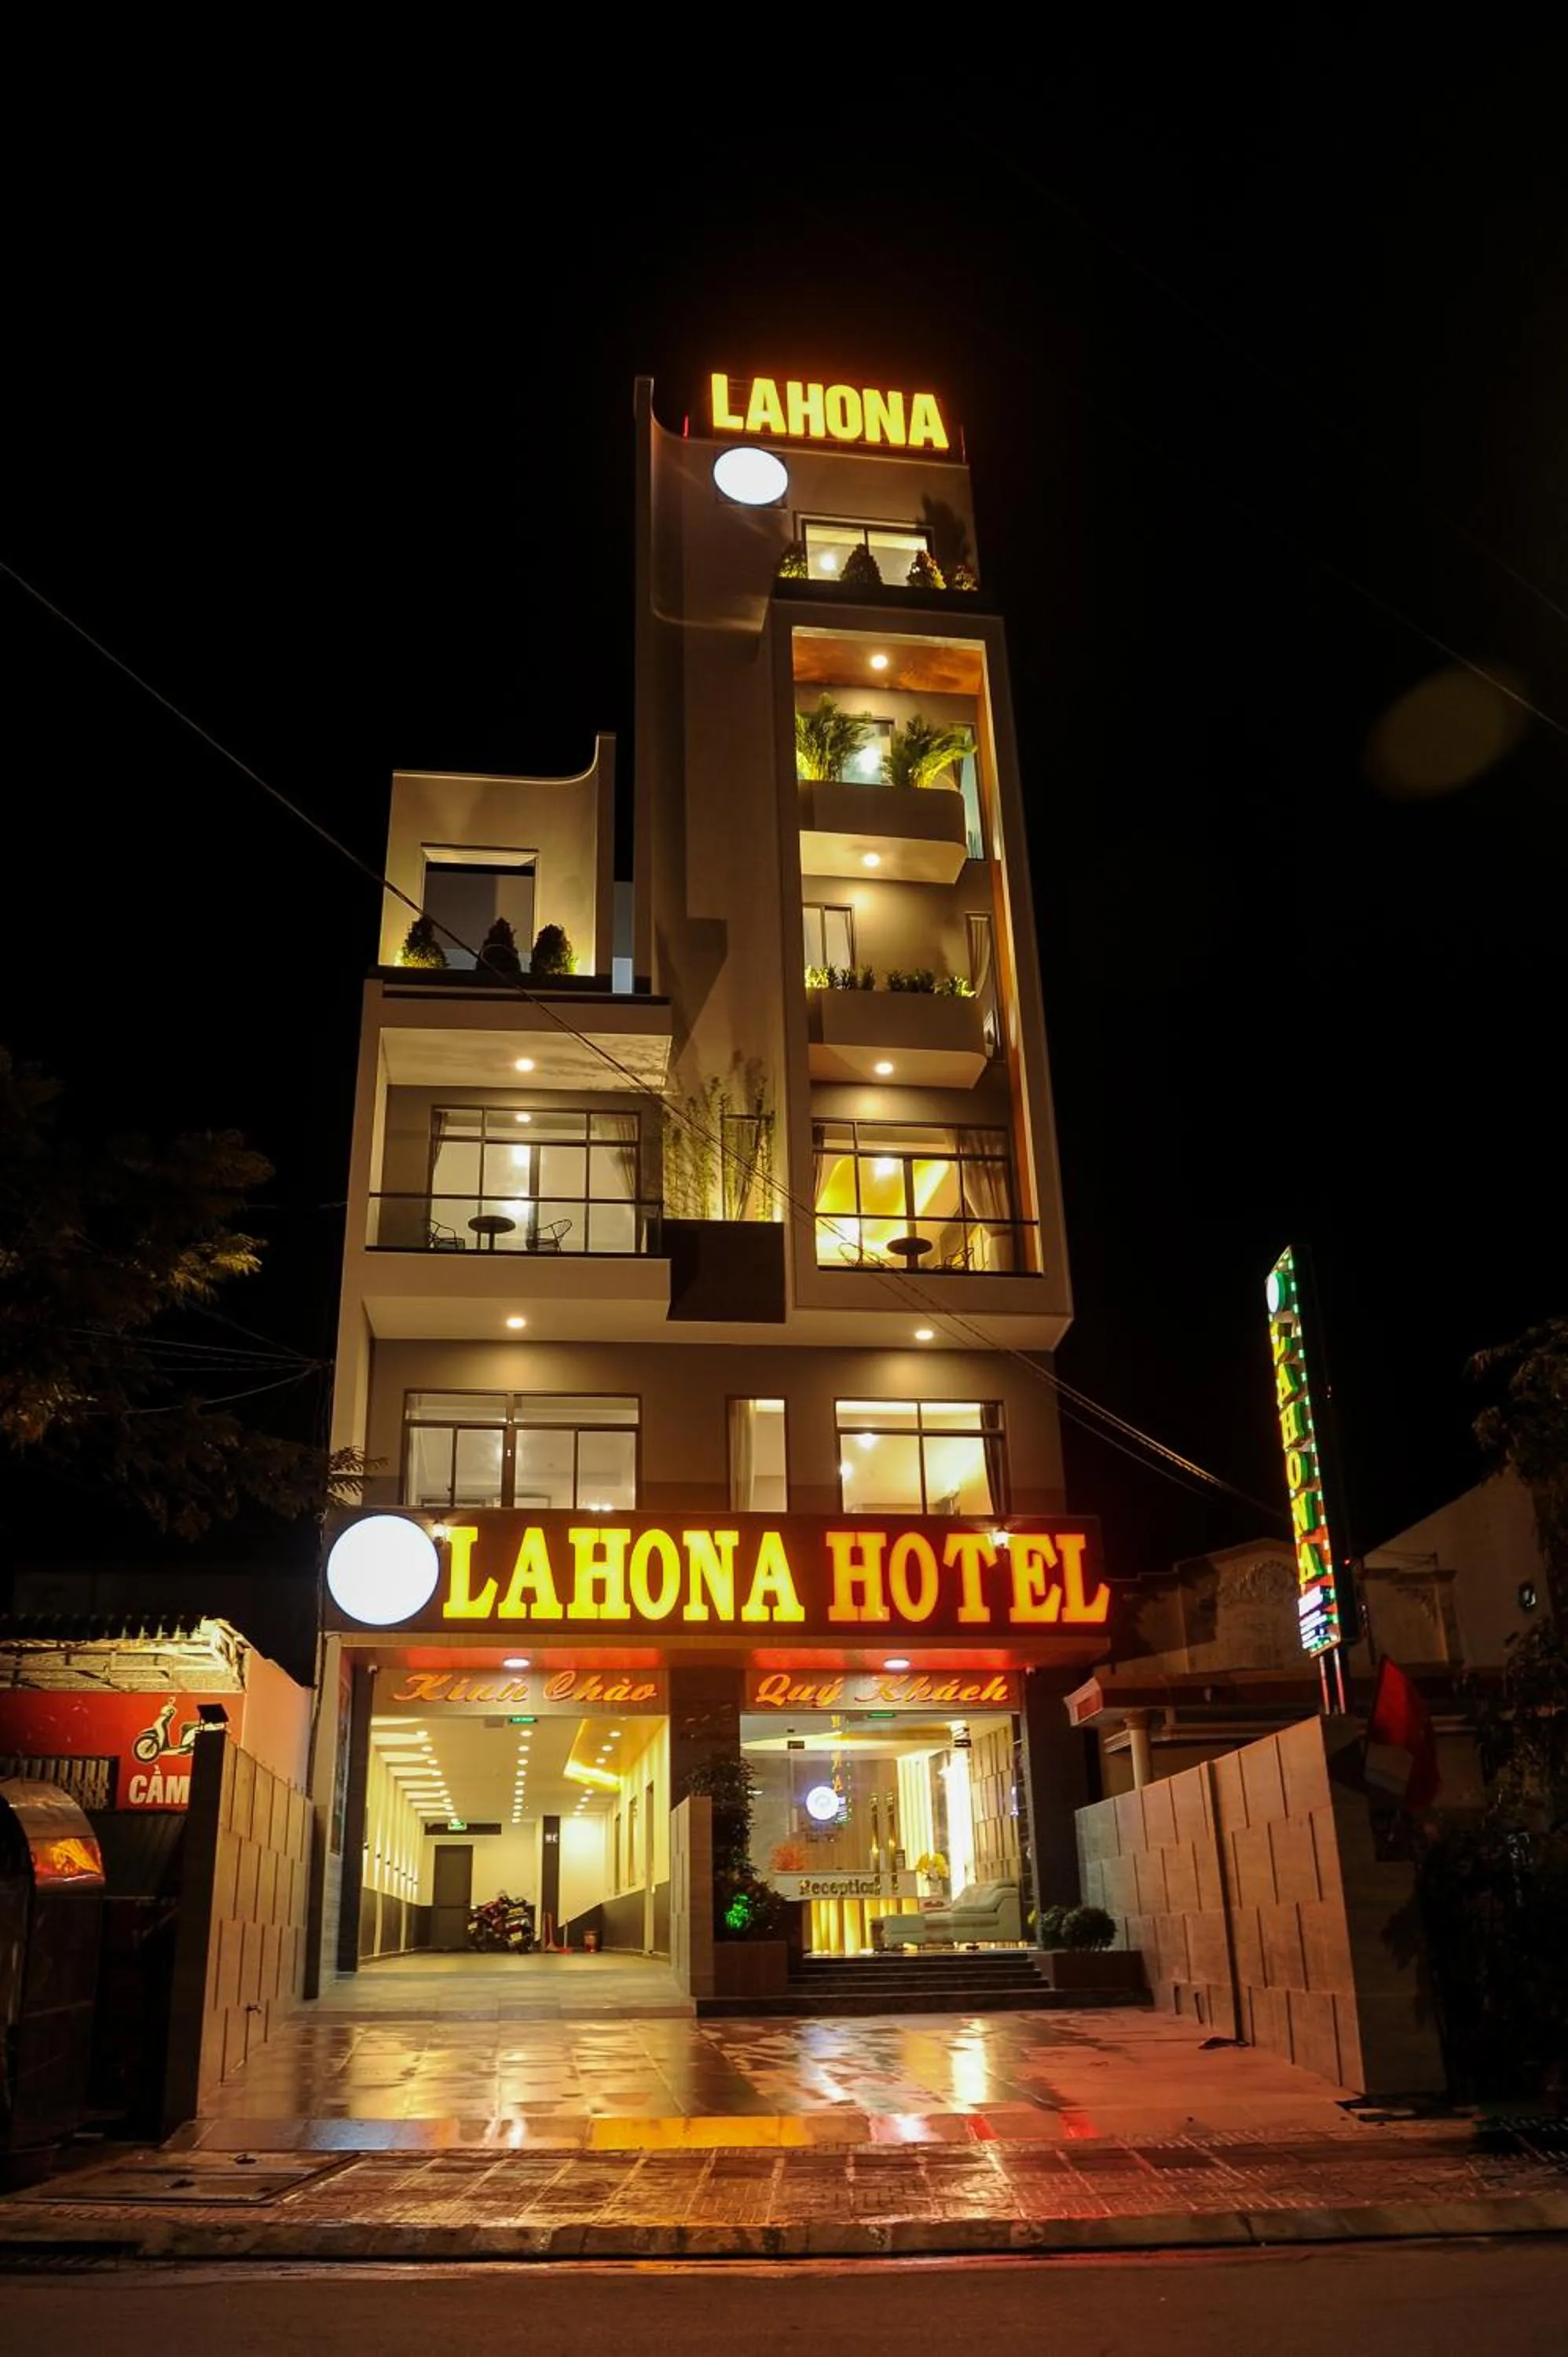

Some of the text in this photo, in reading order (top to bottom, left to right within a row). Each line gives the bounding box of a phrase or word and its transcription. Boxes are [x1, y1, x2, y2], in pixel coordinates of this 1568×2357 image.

[711, 373, 949, 449] LAHONA
[1269, 1321, 1318, 1585] LAHONA
[443, 1527, 1110, 1623] LAHONA HOTEL
[543, 1670, 658, 1701] Chào
[756, 1673, 1009, 1707] Quý Khách
